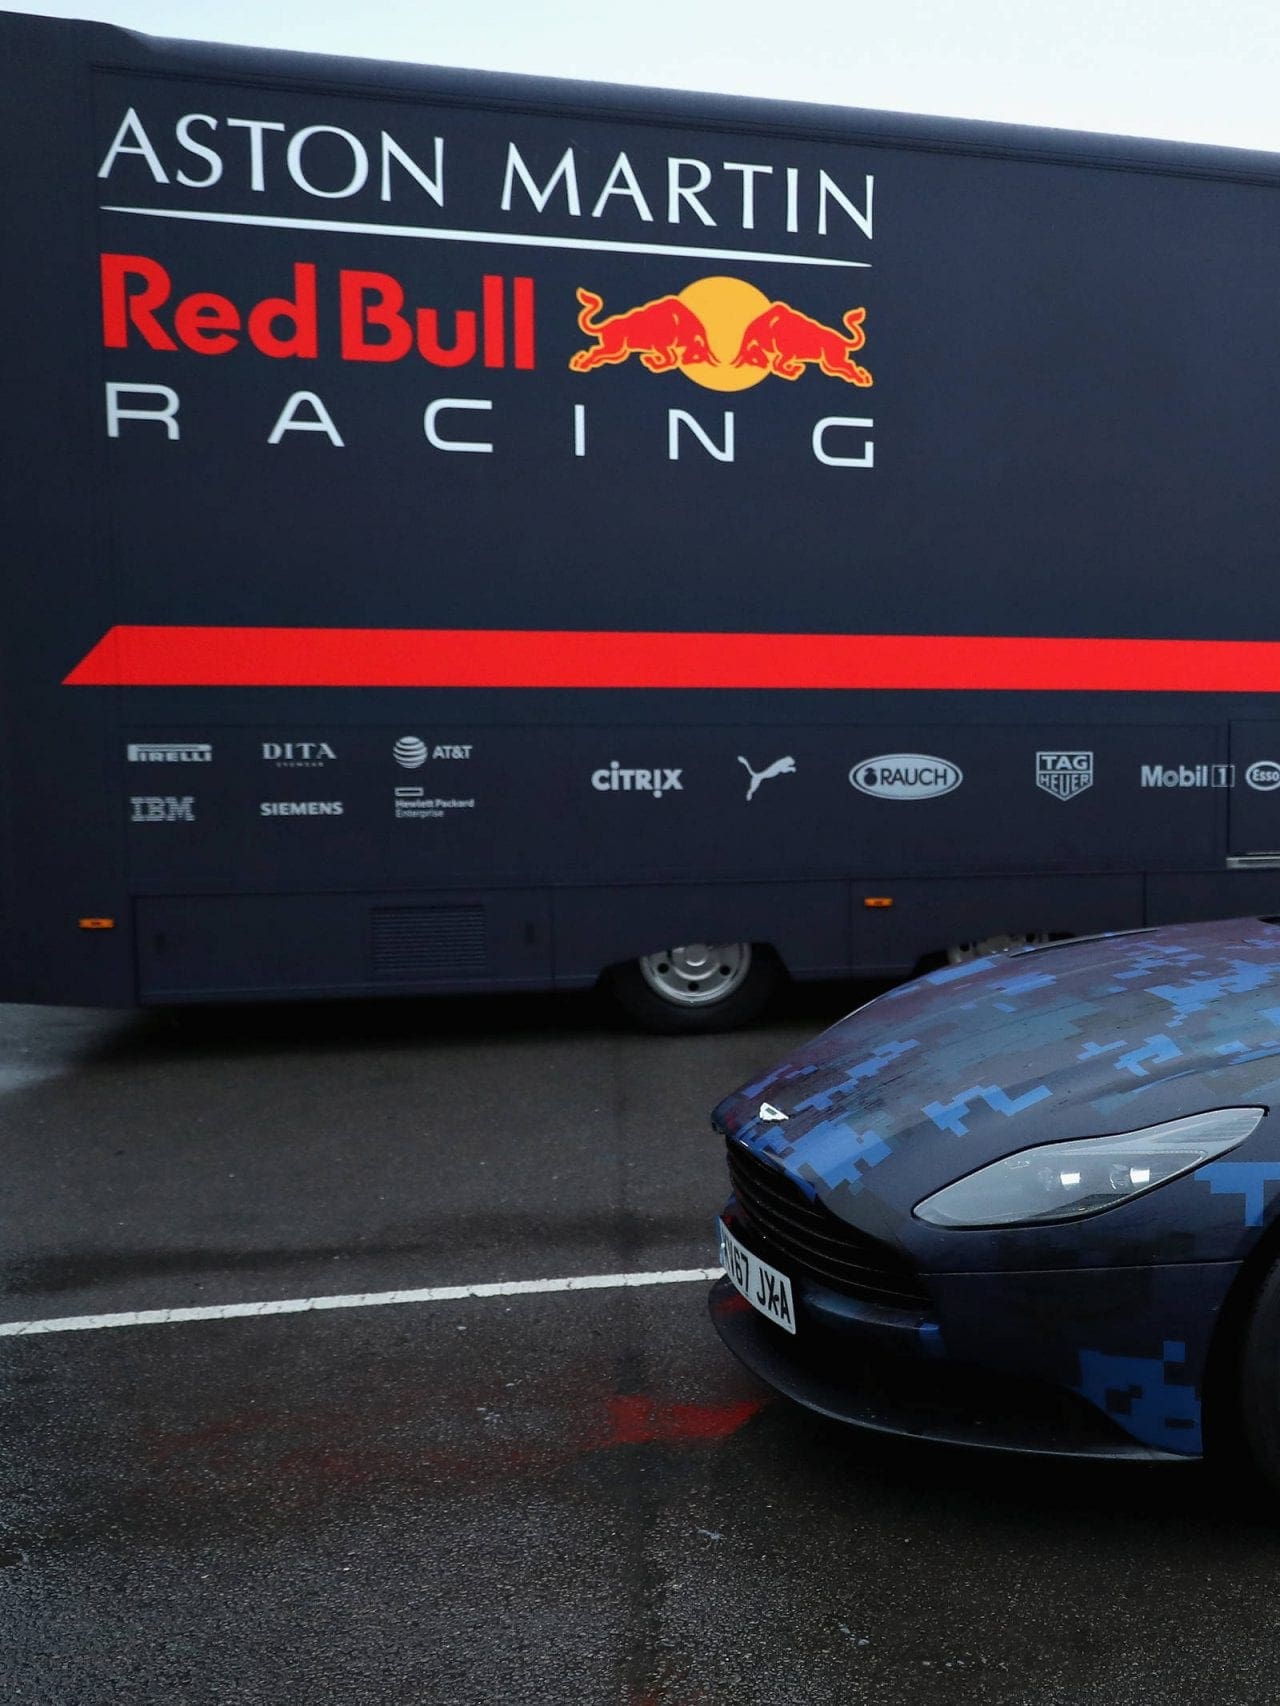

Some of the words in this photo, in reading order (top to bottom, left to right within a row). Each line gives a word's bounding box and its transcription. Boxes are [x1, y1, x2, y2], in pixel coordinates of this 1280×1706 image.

[97, 107, 444, 207] ASTON
[500, 141, 875, 240] MARTIN
[100, 253, 318, 359] Red
[339, 269, 535, 370] Bull
[105, 382, 875, 468] RACING
[127, 743, 212, 762] PIRELLI
[262, 742, 337, 760] DITA
[431, 744, 473, 760] AT&T
[1042, 756, 1088, 770] TAG
[880, 768, 947, 786] RAUCH
[1040, 774, 1090, 797] HEUER
[1140, 764, 1209, 788] Mobil
[1217, 767, 1227, 785] 1
[1252, 769, 1280, 783] Esso
[130, 796, 195, 822] IBM
[260, 801, 344, 817] SIEMENS
[757, 1266, 792, 1325] JXA
